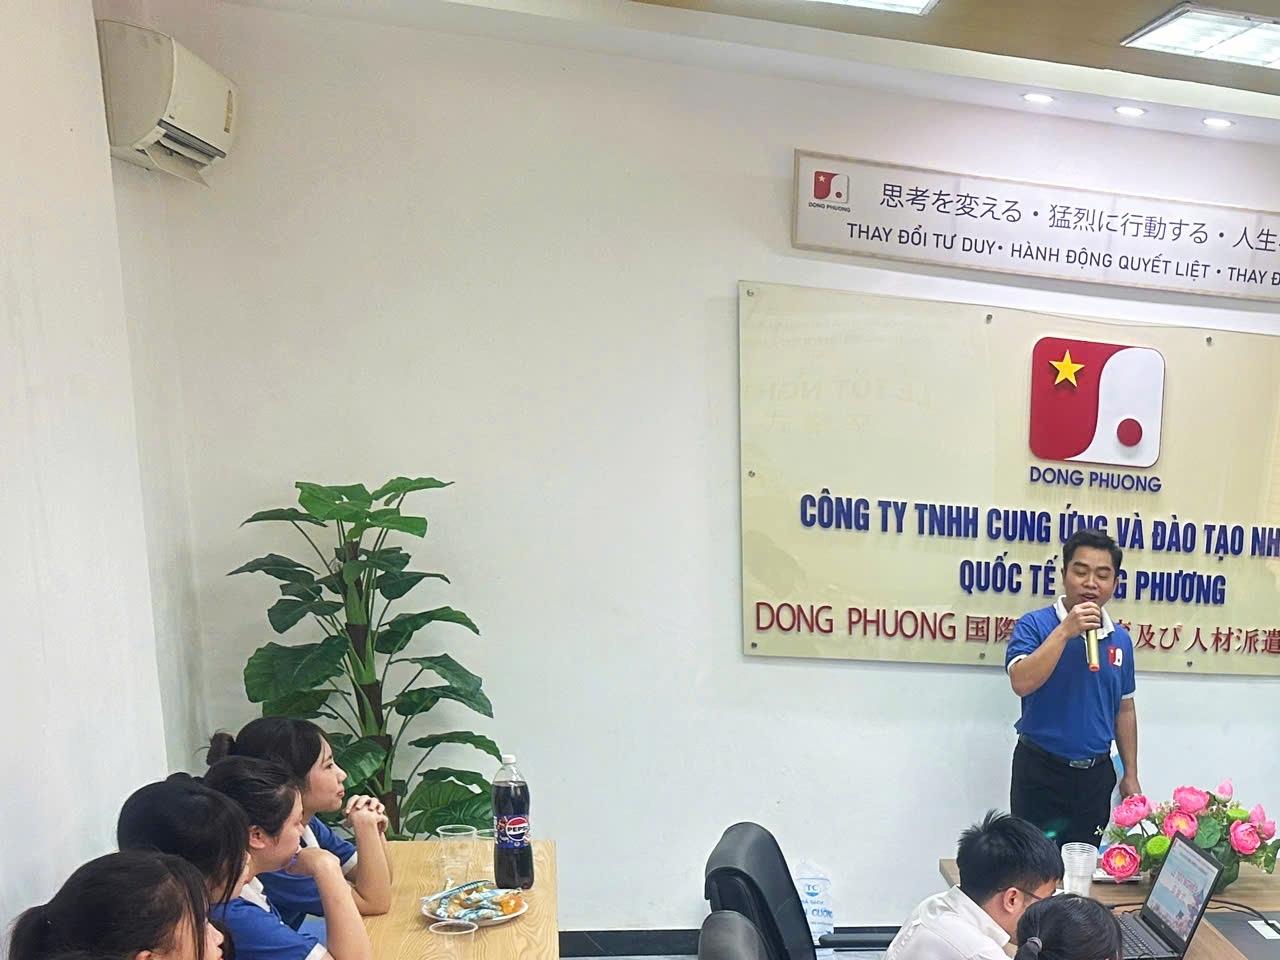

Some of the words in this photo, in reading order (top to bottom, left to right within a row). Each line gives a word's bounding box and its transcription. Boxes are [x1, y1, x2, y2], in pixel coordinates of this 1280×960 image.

[848, 223, 892, 243] THAY
[898, 225, 927, 246] ĐỔI
[933, 233, 957, 249] TƯ
[962, 237, 996, 255] DUY
[1011, 243, 1060, 262] HÀNH
[1066, 246, 1112, 269] ĐỘNG
[1118, 253, 1171, 275] QUYẾT
[1176, 261, 1211, 282] LIỆT
[1228, 267, 1268, 285] THAY
[1030, 466, 1084, 487] DONG
[1089, 472, 1162, 493] PHUONG
[800, 488, 870, 532] CÔNG
[878, 500, 907, 533] TY
[914, 503, 979, 539] TNHH
[987, 508, 1050, 544] CUNG
[1117, 512, 1144, 550] VÀ
[1152, 514, 1197, 554] ĐÀO
[1204, 523, 1244, 561] TẠO
[960, 551, 1022, 594] QUỐC
[1030, 555, 1058, 596] TẾ
[1135, 569, 1226, 605] PHƯƠNG
[756, 602, 833, 634] DONG
[848, 607, 956, 640] PHUONG
